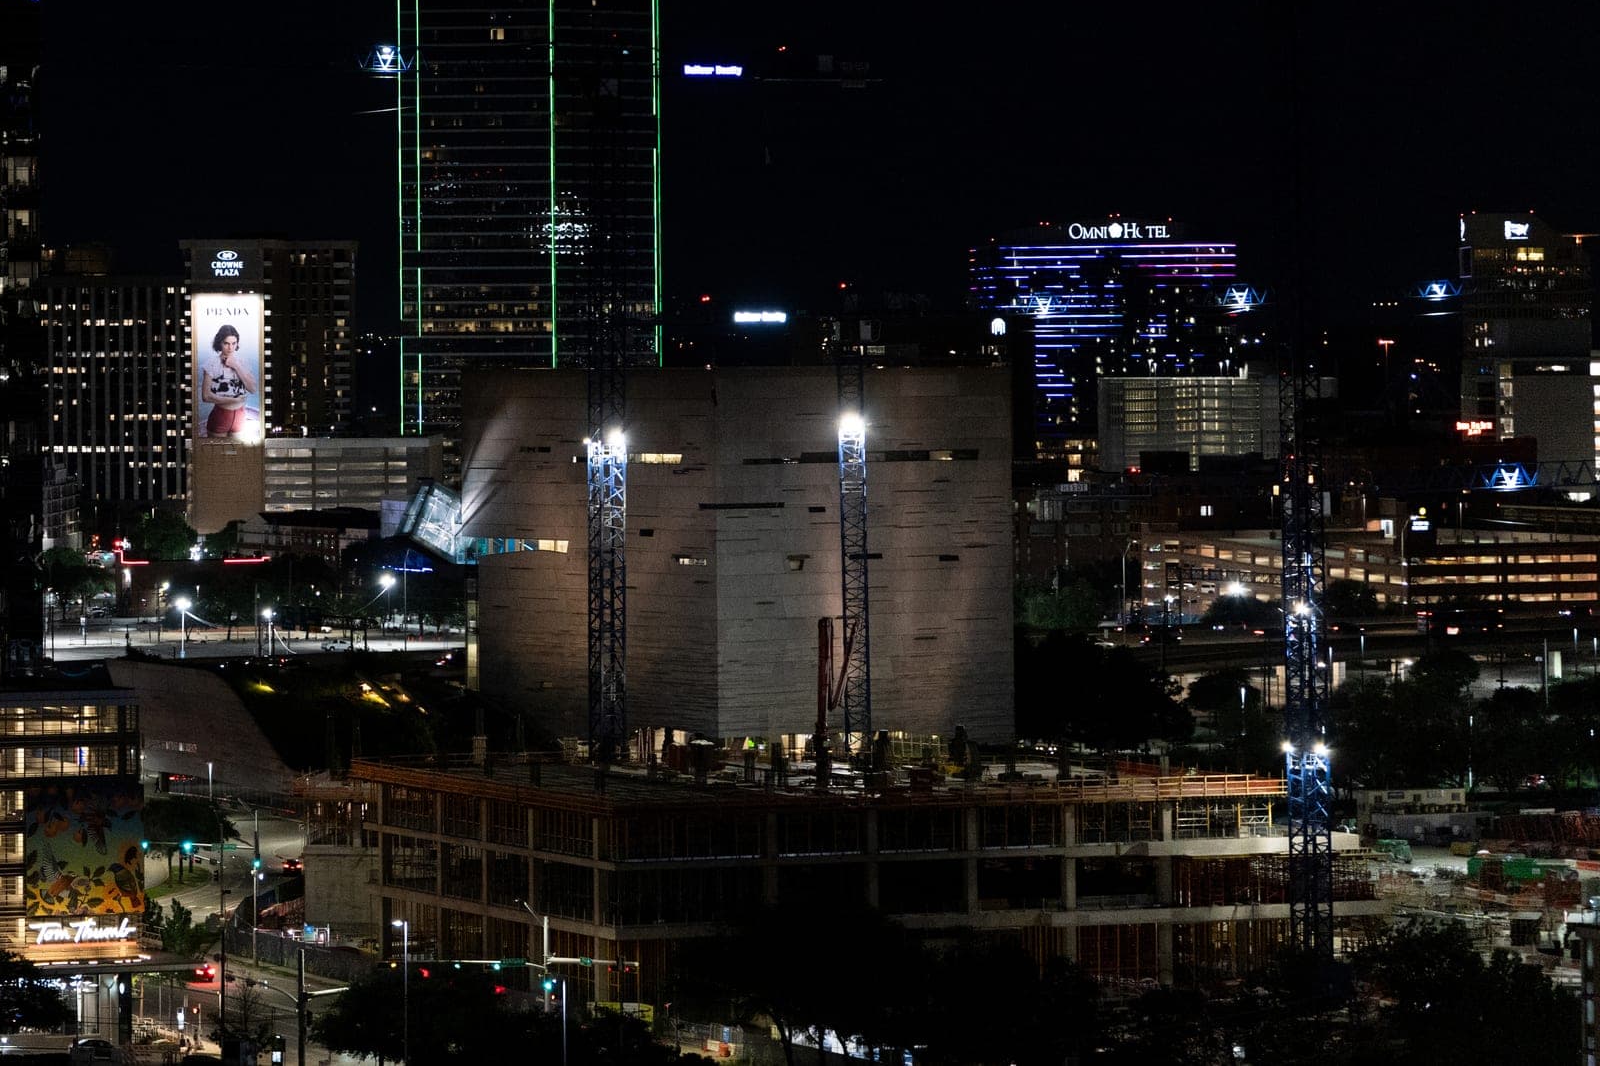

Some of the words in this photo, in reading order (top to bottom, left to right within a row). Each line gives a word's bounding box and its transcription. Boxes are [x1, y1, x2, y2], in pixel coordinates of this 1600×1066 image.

[1068, 223, 1108, 240] OMNI
[211, 261, 243, 269] CROWNE
[214, 268, 240, 277] PLAZA
[28, 922, 71, 945] Tom
[69, 917, 137, 944] Thumb
